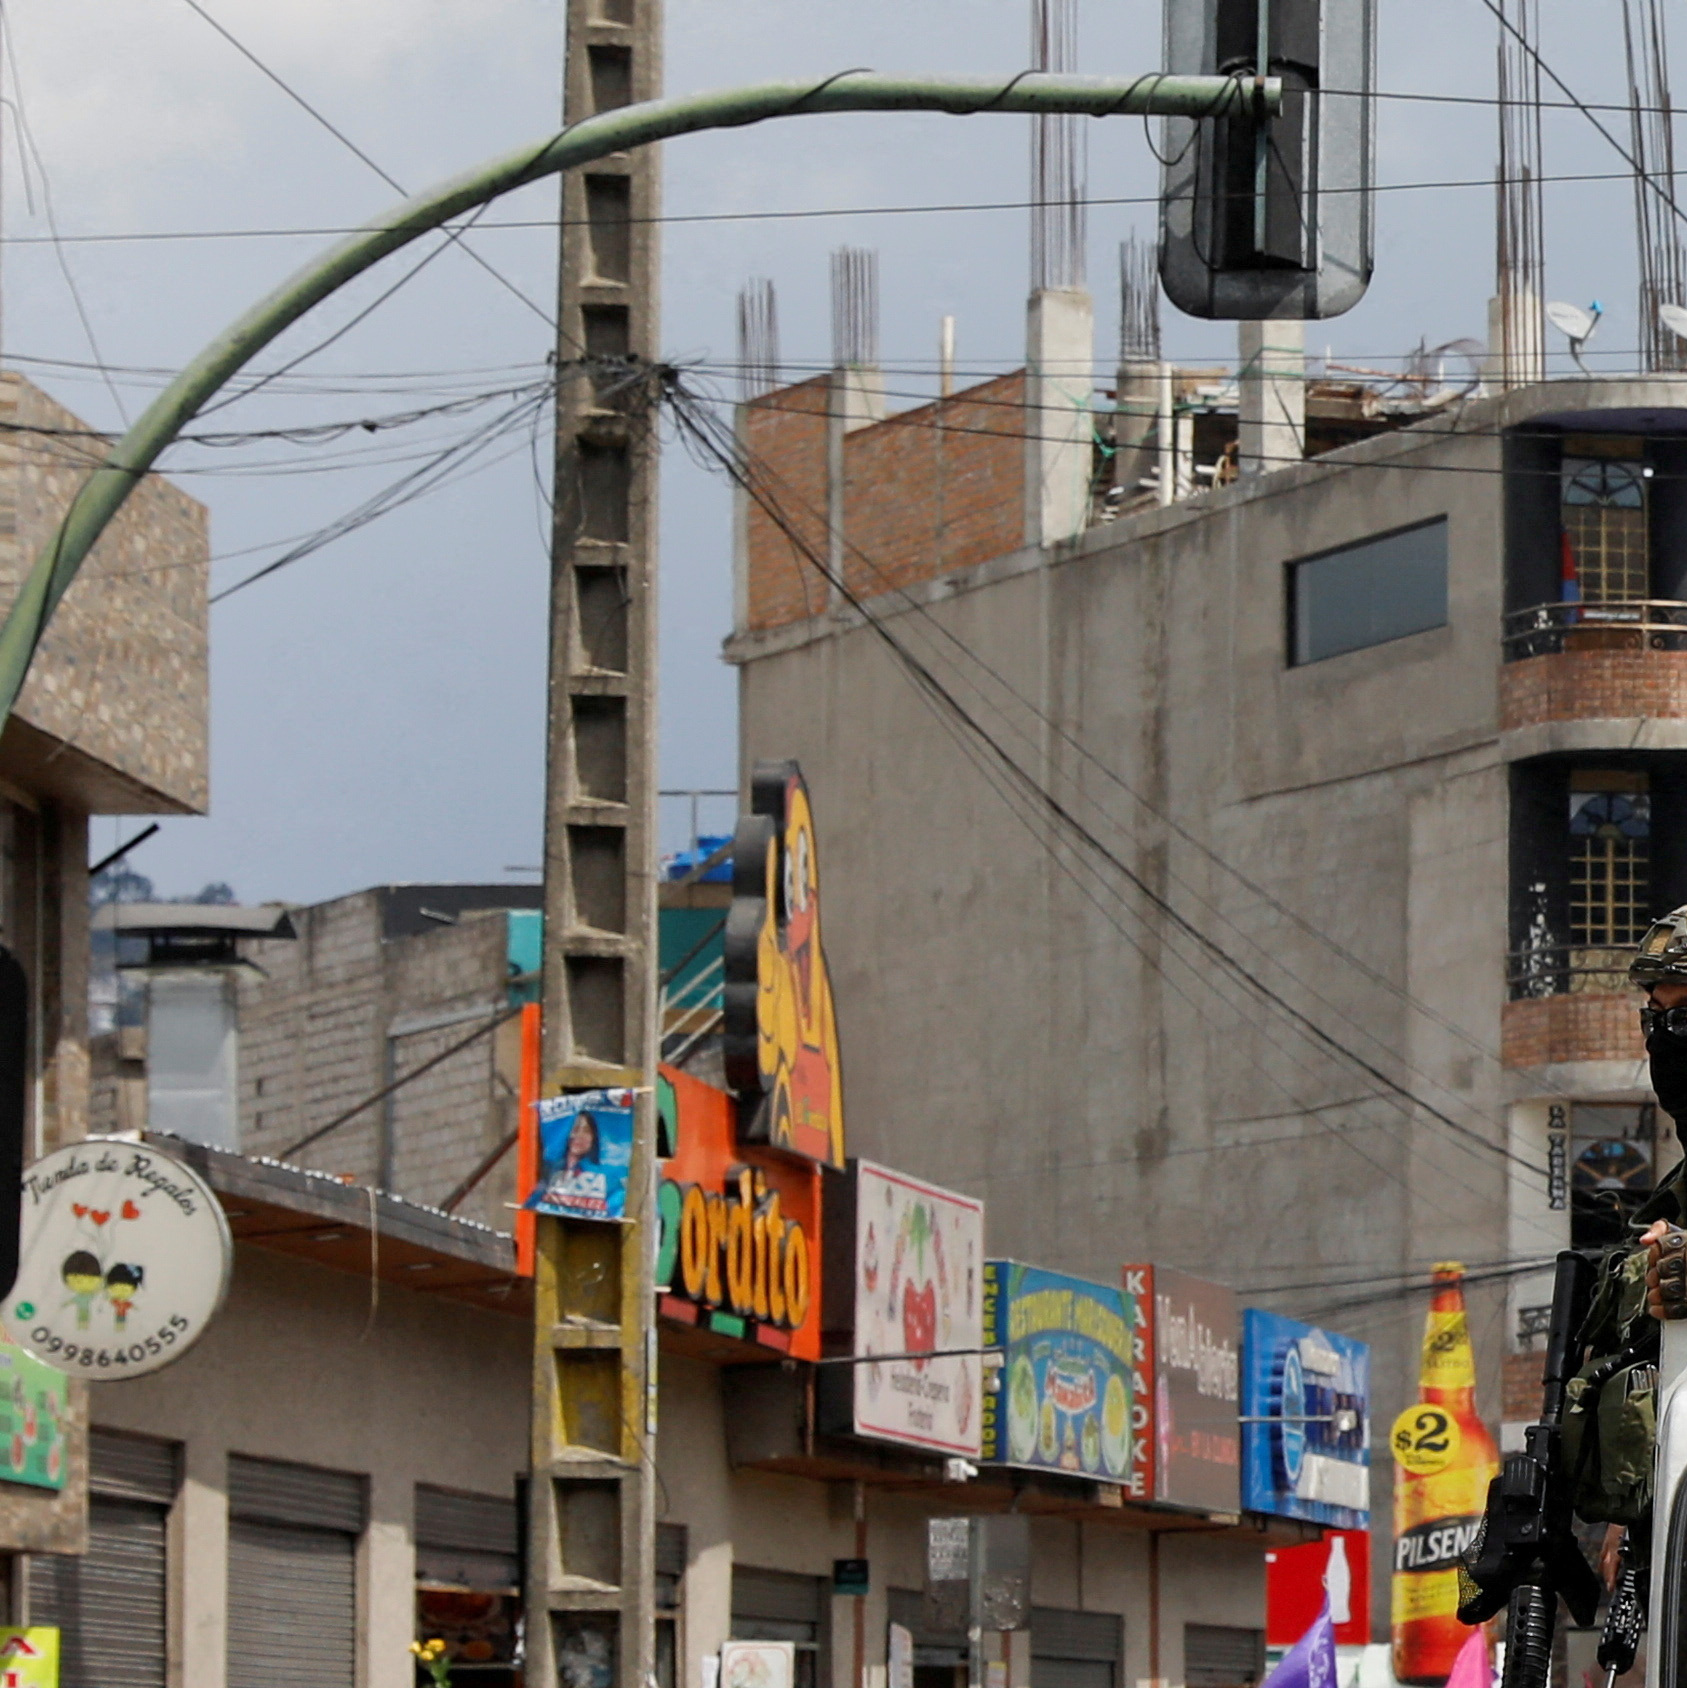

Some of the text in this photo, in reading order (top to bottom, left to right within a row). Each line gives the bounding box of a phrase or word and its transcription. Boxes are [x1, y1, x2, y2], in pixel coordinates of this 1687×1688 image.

[24, 1152, 197, 1216] Tienda de Regalos
[32, 1314, 188, 1368] 0998640555
[1126, 1270, 1149, 1497] KARAOKE
[1395, 1412, 1450, 1454] $2
